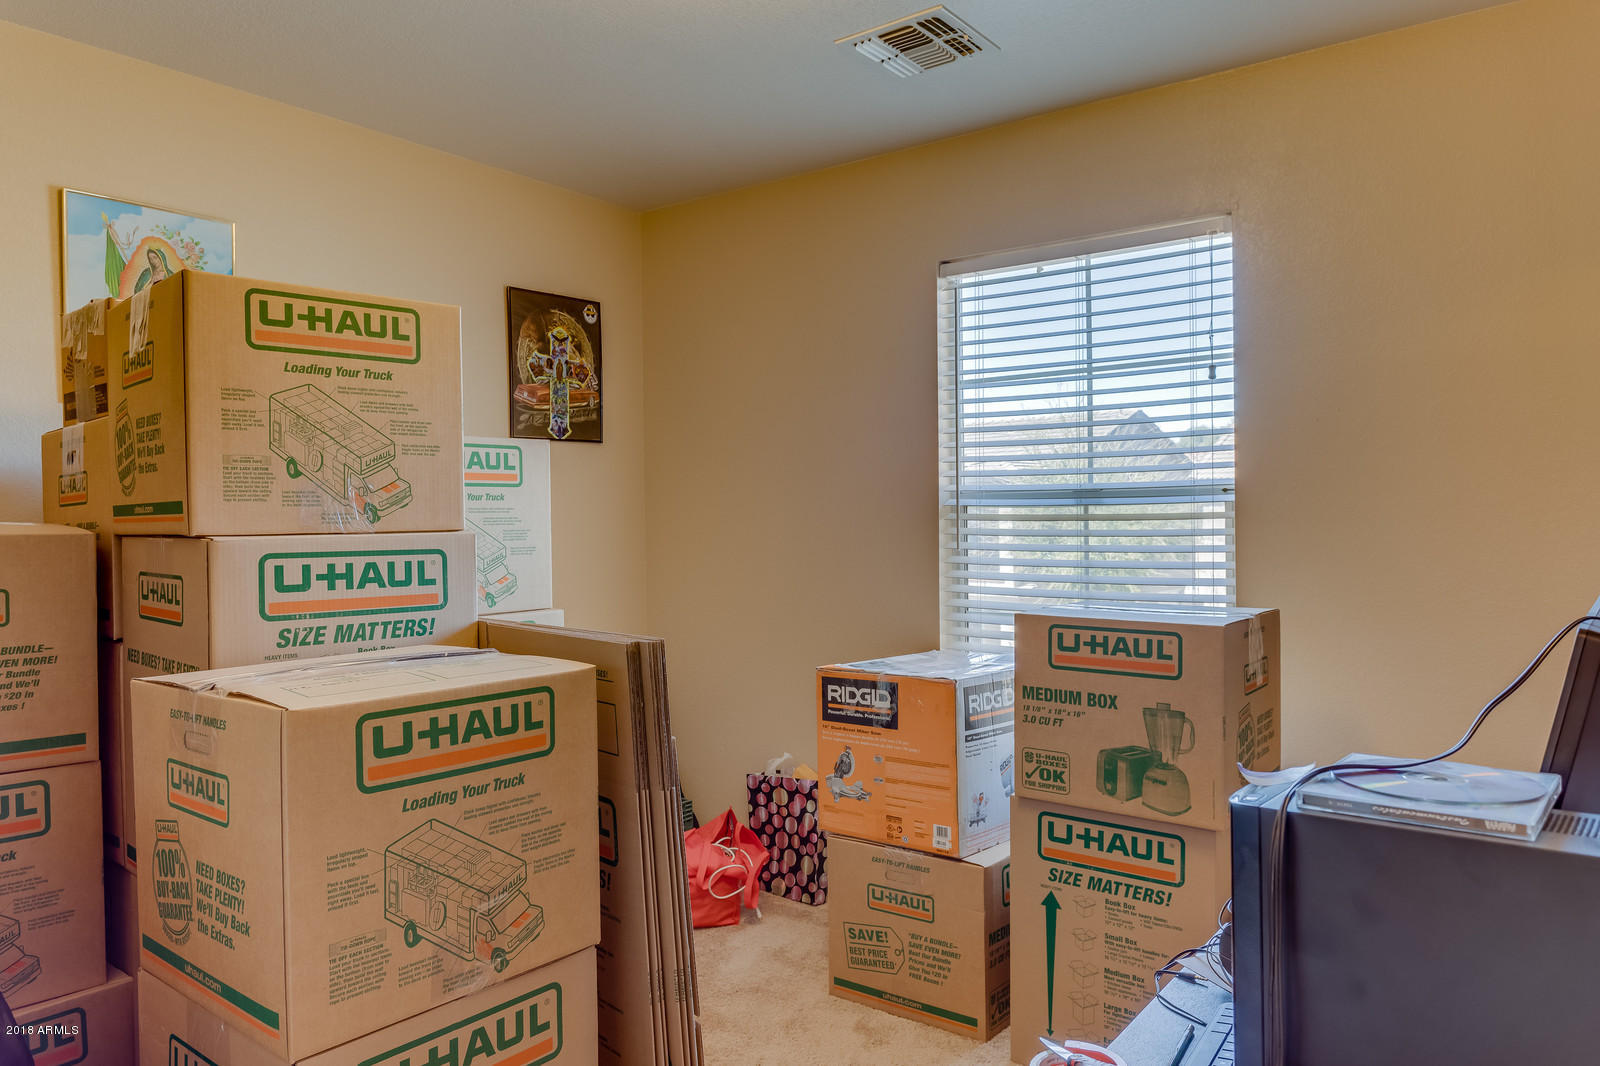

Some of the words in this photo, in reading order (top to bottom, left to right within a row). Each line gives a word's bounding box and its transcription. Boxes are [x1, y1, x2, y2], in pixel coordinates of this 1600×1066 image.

[259, 300, 411, 342] U-HAUL
[283, 361, 332, 378] Loading
[335, 366, 361, 379] Your
[364, 368, 393, 381] Truck
[464, 451, 516, 471] AUL
[467, 492, 484, 501] Your
[485, 493, 505, 501] Truck
[273, 560, 437, 593] U-HAUL
[141, 579, 180, 606] U-HAUL
[276, 626, 327, 649] SIZE
[333, 618, 435, 644] MATTERS!
[1057, 632, 1173, 661] U-HAUL
[22, 655, 58, 667] MORE!
[128, 647, 140, 664] NEED
[141, 651, 160, 671] BOXES?
[162, 657, 175, 674] TAKE
[5, 669, 41, 679] Bundle
[15, 679, 41, 689] We'll
[24, 690, 34, 699] in
[827, 684, 892, 709] RIDGID
[1022, 685, 1082, 706] MEDIUM
[1087, 692, 1118, 710] BOX
[170, 708, 202, 725] EASY-TO-LIFT
[203, 715, 226, 731] HANDLES
[1022, 714, 1036, 723] 3.0
[1038, 716, 1051, 726] CU
[1052, 718, 1064, 727] FT
[1053, 708, 1067, 716] 18"
[372, 701, 544, 759] U-HAUL
[1035, 752, 1067, 762] U-HAUL
[1035, 759, 1067, 769] BOXES
[1025, 780, 1037, 788] FOR
[1038, 781, 1067, 792] SHIPPING
[1039, 768, 1066, 784] OK
[170, 767, 225, 806] U-HAUL
[402, 789, 458, 812] Loading
[461, 780, 491, 800] Your
[493, 772, 526, 792] Truck
[1047, 820, 1174, 865] U-HAUL
[156, 849, 186, 878] 100%
[871, 856, 906, 869] EASY-TO-LIFT
[196, 860, 214, 880] NEED
[216, 866, 246, 895] BOXES?
[1048, 867, 1083, 888] SIZE
[1087, 875, 1173, 907] MATTERS!
[157, 880, 190, 900] BUY-BACK
[196, 879, 213, 899] TAKE
[214, 887, 245, 914] PLENTY!
[871, 888, 930, 913] U-HAUL
[1104, 898, 1121, 908] Book
[1123, 901, 1136, 910] Box
[157, 902, 193, 922] GUARANTEE
[196, 897, 213, 918] We'll
[215, 908, 228, 928] Buy
[231, 918, 251, 937] Back
[197, 918, 209, 936] the
[210, 925, 236, 951] Extras.
[847, 927, 889, 943] SAVE!
[1104, 932, 1123, 943] Small
[1125, 937, 1137, 946] Box
[849, 946, 866, 957] BEST
[867, 948, 888, 959] PRICE
[908, 941, 923, 951] SAVE
[924, 945, 942, 955] EVEN
[943, 948, 961, 960] MORE!
[908, 950, 921, 958] Beat
[922, 952, 931, 960] Our
[932, 953, 951, 965] Bundle
[908, 957, 925, 966] Prices
[926, 960, 936, 968] and
[908, 965, 921, 973] Give
[922, 967, 931, 975] You
[184, 963, 222, 993] uhaul.com
[908, 972, 922, 981] FREE
[923, 976, 939, 985] Boxes
[1104, 967, 1130, 979] Medium
[1132, 973, 1145, 984] Box
[883, 992, 923, 1010] uhaul.com
[1103, 1002, 1122, 1013] Large
[1124, 1007, 1136, 1016] Box
